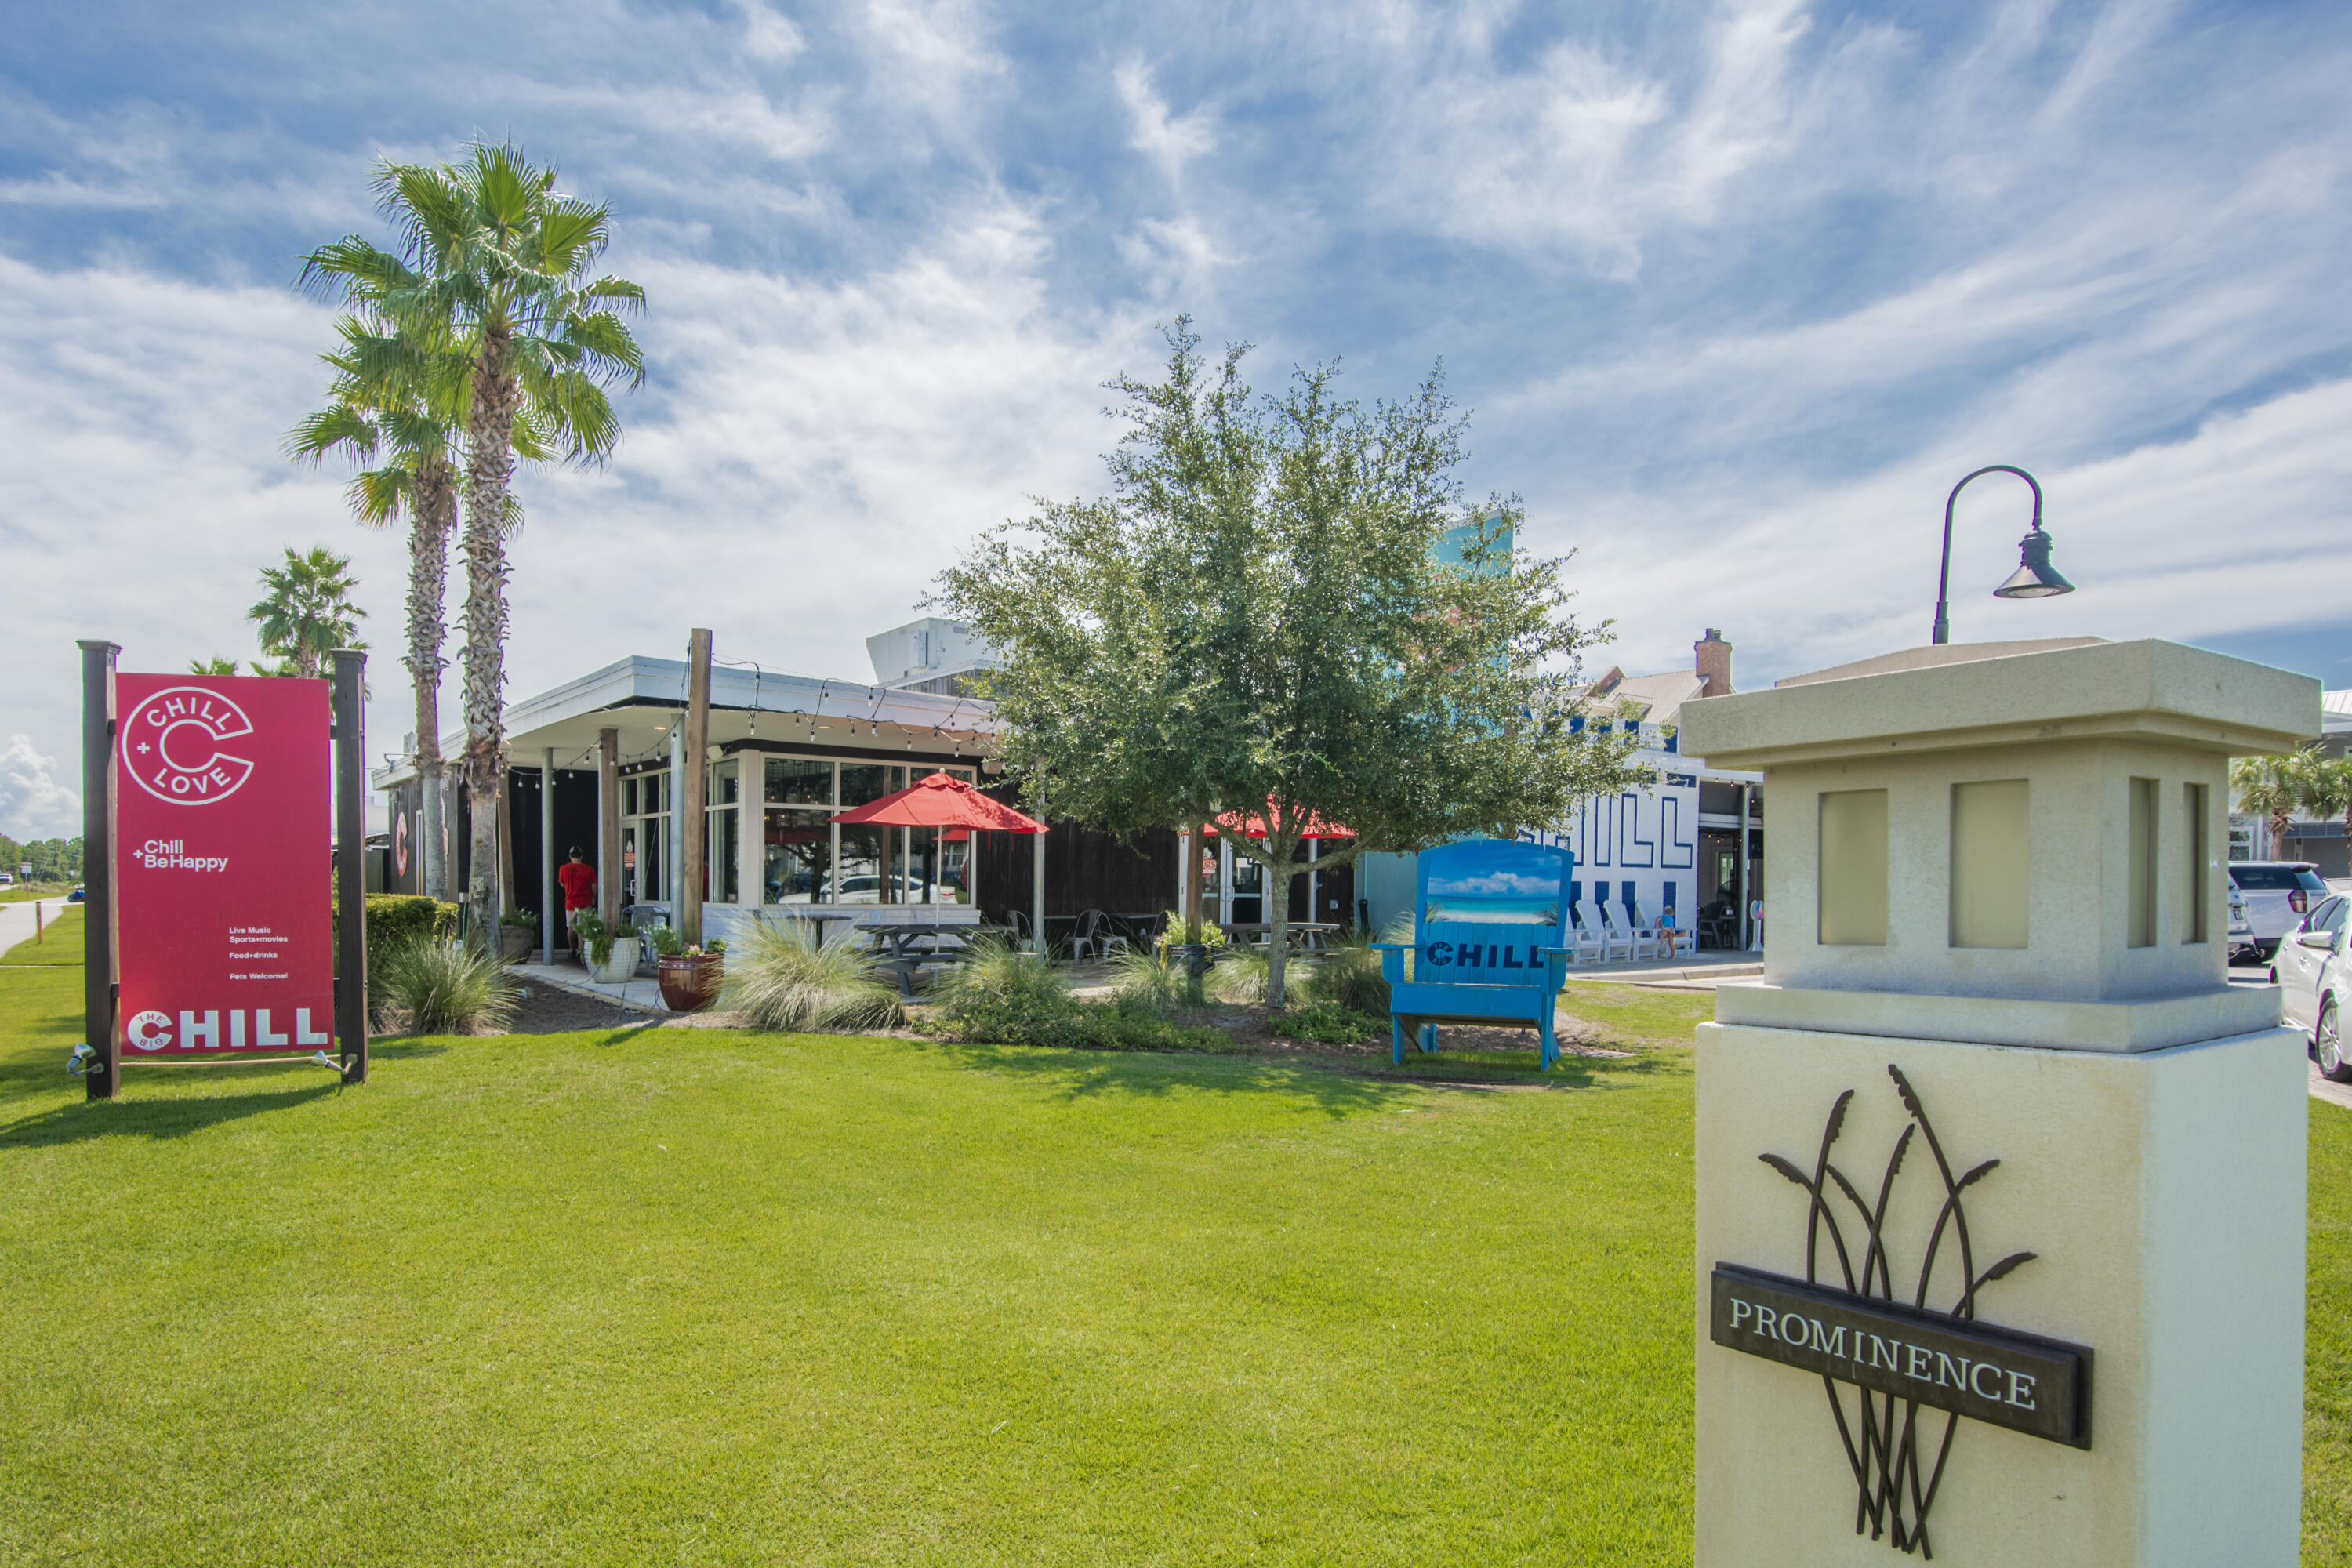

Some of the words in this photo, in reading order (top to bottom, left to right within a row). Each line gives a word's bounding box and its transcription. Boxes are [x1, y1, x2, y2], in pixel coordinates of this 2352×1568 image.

[147, 697, 232, 731] CHILL
[153, 766, 232, 794] LOVE
[144, 839, 183, 854] Chill
[229, 935, 289, 945] Sports+movies
[1427, 941, 1544, 968] CHILL
[127, 1007, 328, 1051] CHILL
[137, 1013, 164, 1023] THE
[139, 1038, 163, 1047] BIG
[1730, 1298, 2038, 1411] PROMINENCE
